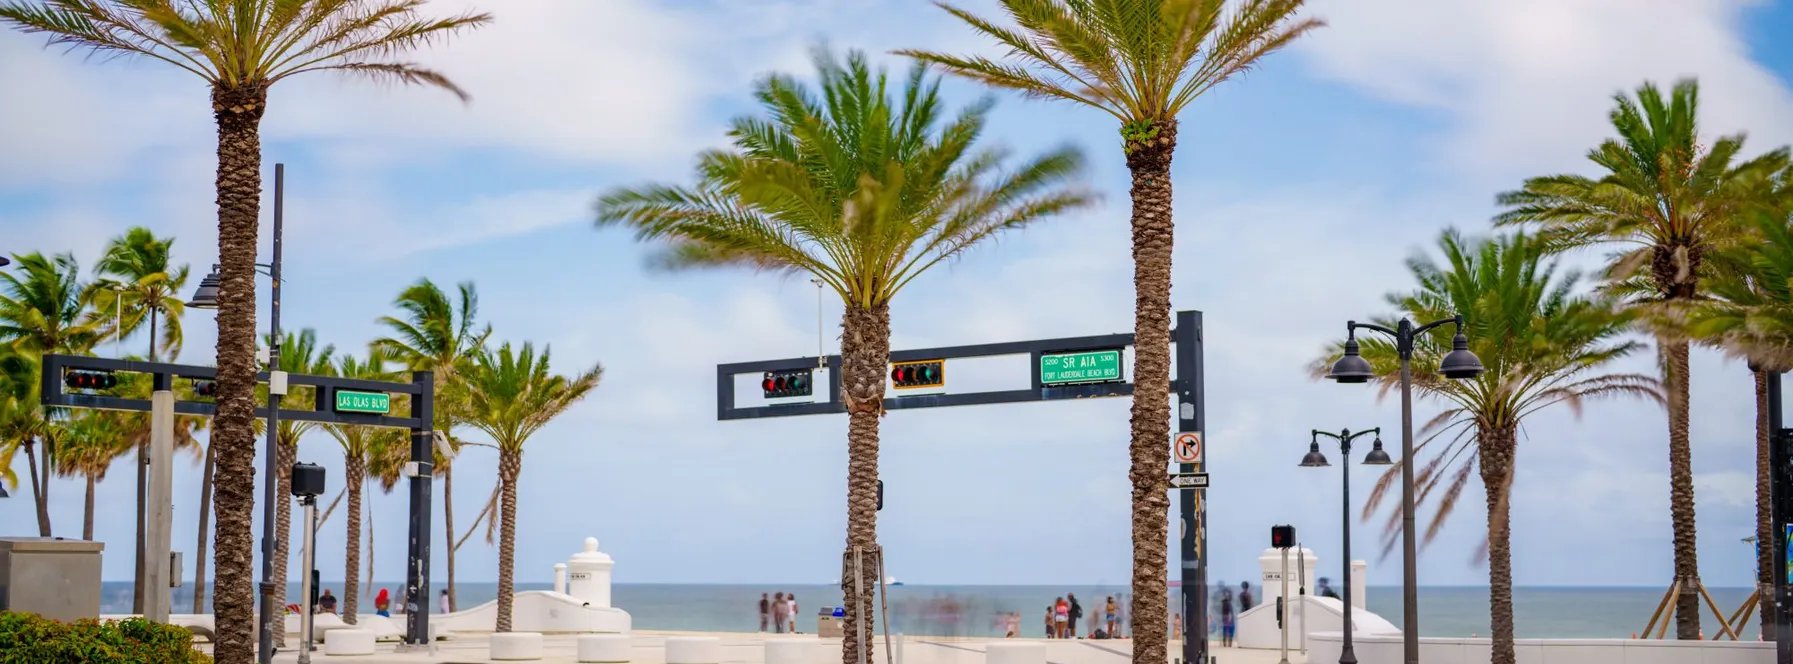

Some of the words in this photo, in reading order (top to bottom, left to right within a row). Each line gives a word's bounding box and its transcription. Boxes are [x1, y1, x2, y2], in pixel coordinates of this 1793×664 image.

[1063, 357, 1075, 368] SR
[1058, 370, 1086, 379] LAUDERDALE
[1087, 368, 1101, 376] BEACH
[339, 396, 350, 406] LAS
[353, 397, 369, 407] OLAS
[372, 398, 387, 408] BLVD
